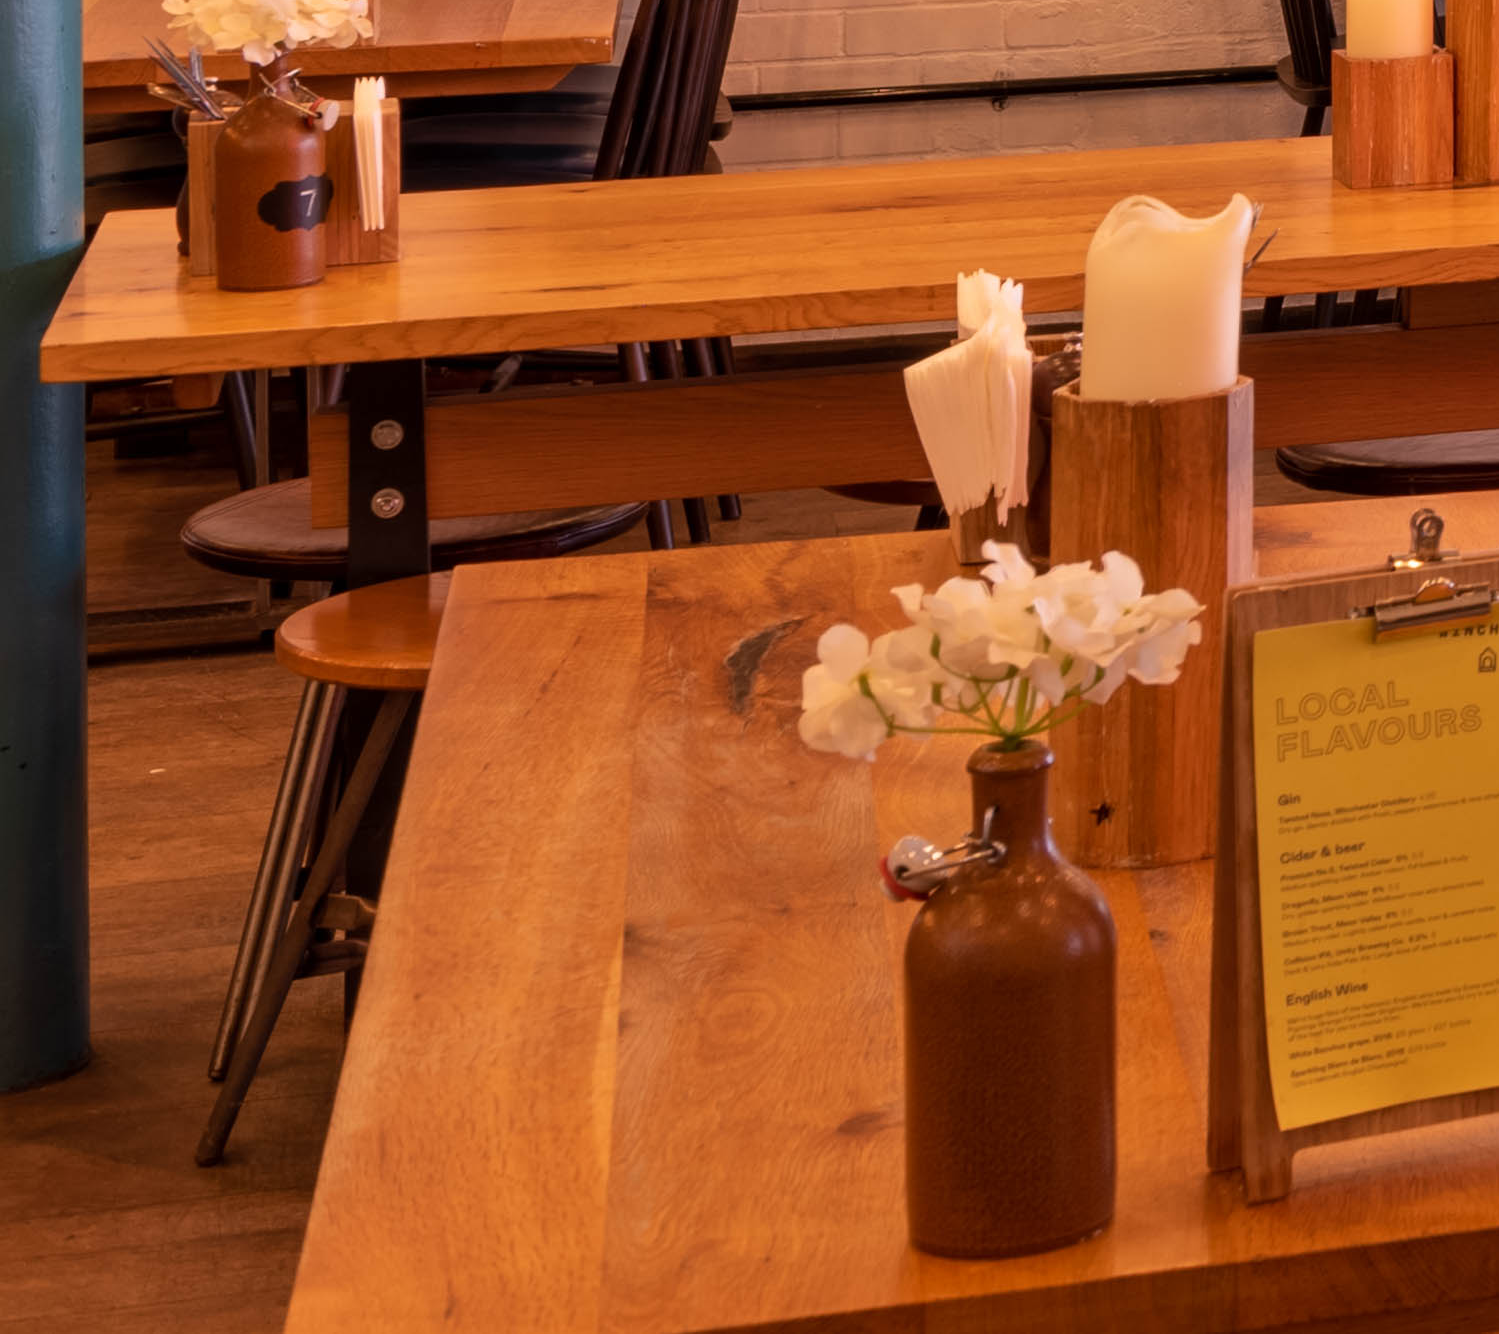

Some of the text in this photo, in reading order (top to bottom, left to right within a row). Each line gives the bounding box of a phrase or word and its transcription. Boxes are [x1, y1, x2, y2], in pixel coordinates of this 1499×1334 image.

[300, 189, 317, 217] 7
[1275, 681, 1410, 726] LOCAL
[1276, 704, 1482, 763] FLAVOURS
[1278, 794, 1301, 806] Gin
[1280, 850, 1316, 864] Cider
[1336, 842, 1366, 854] beer
[1286, 983, 1368, 1007] English Wine
